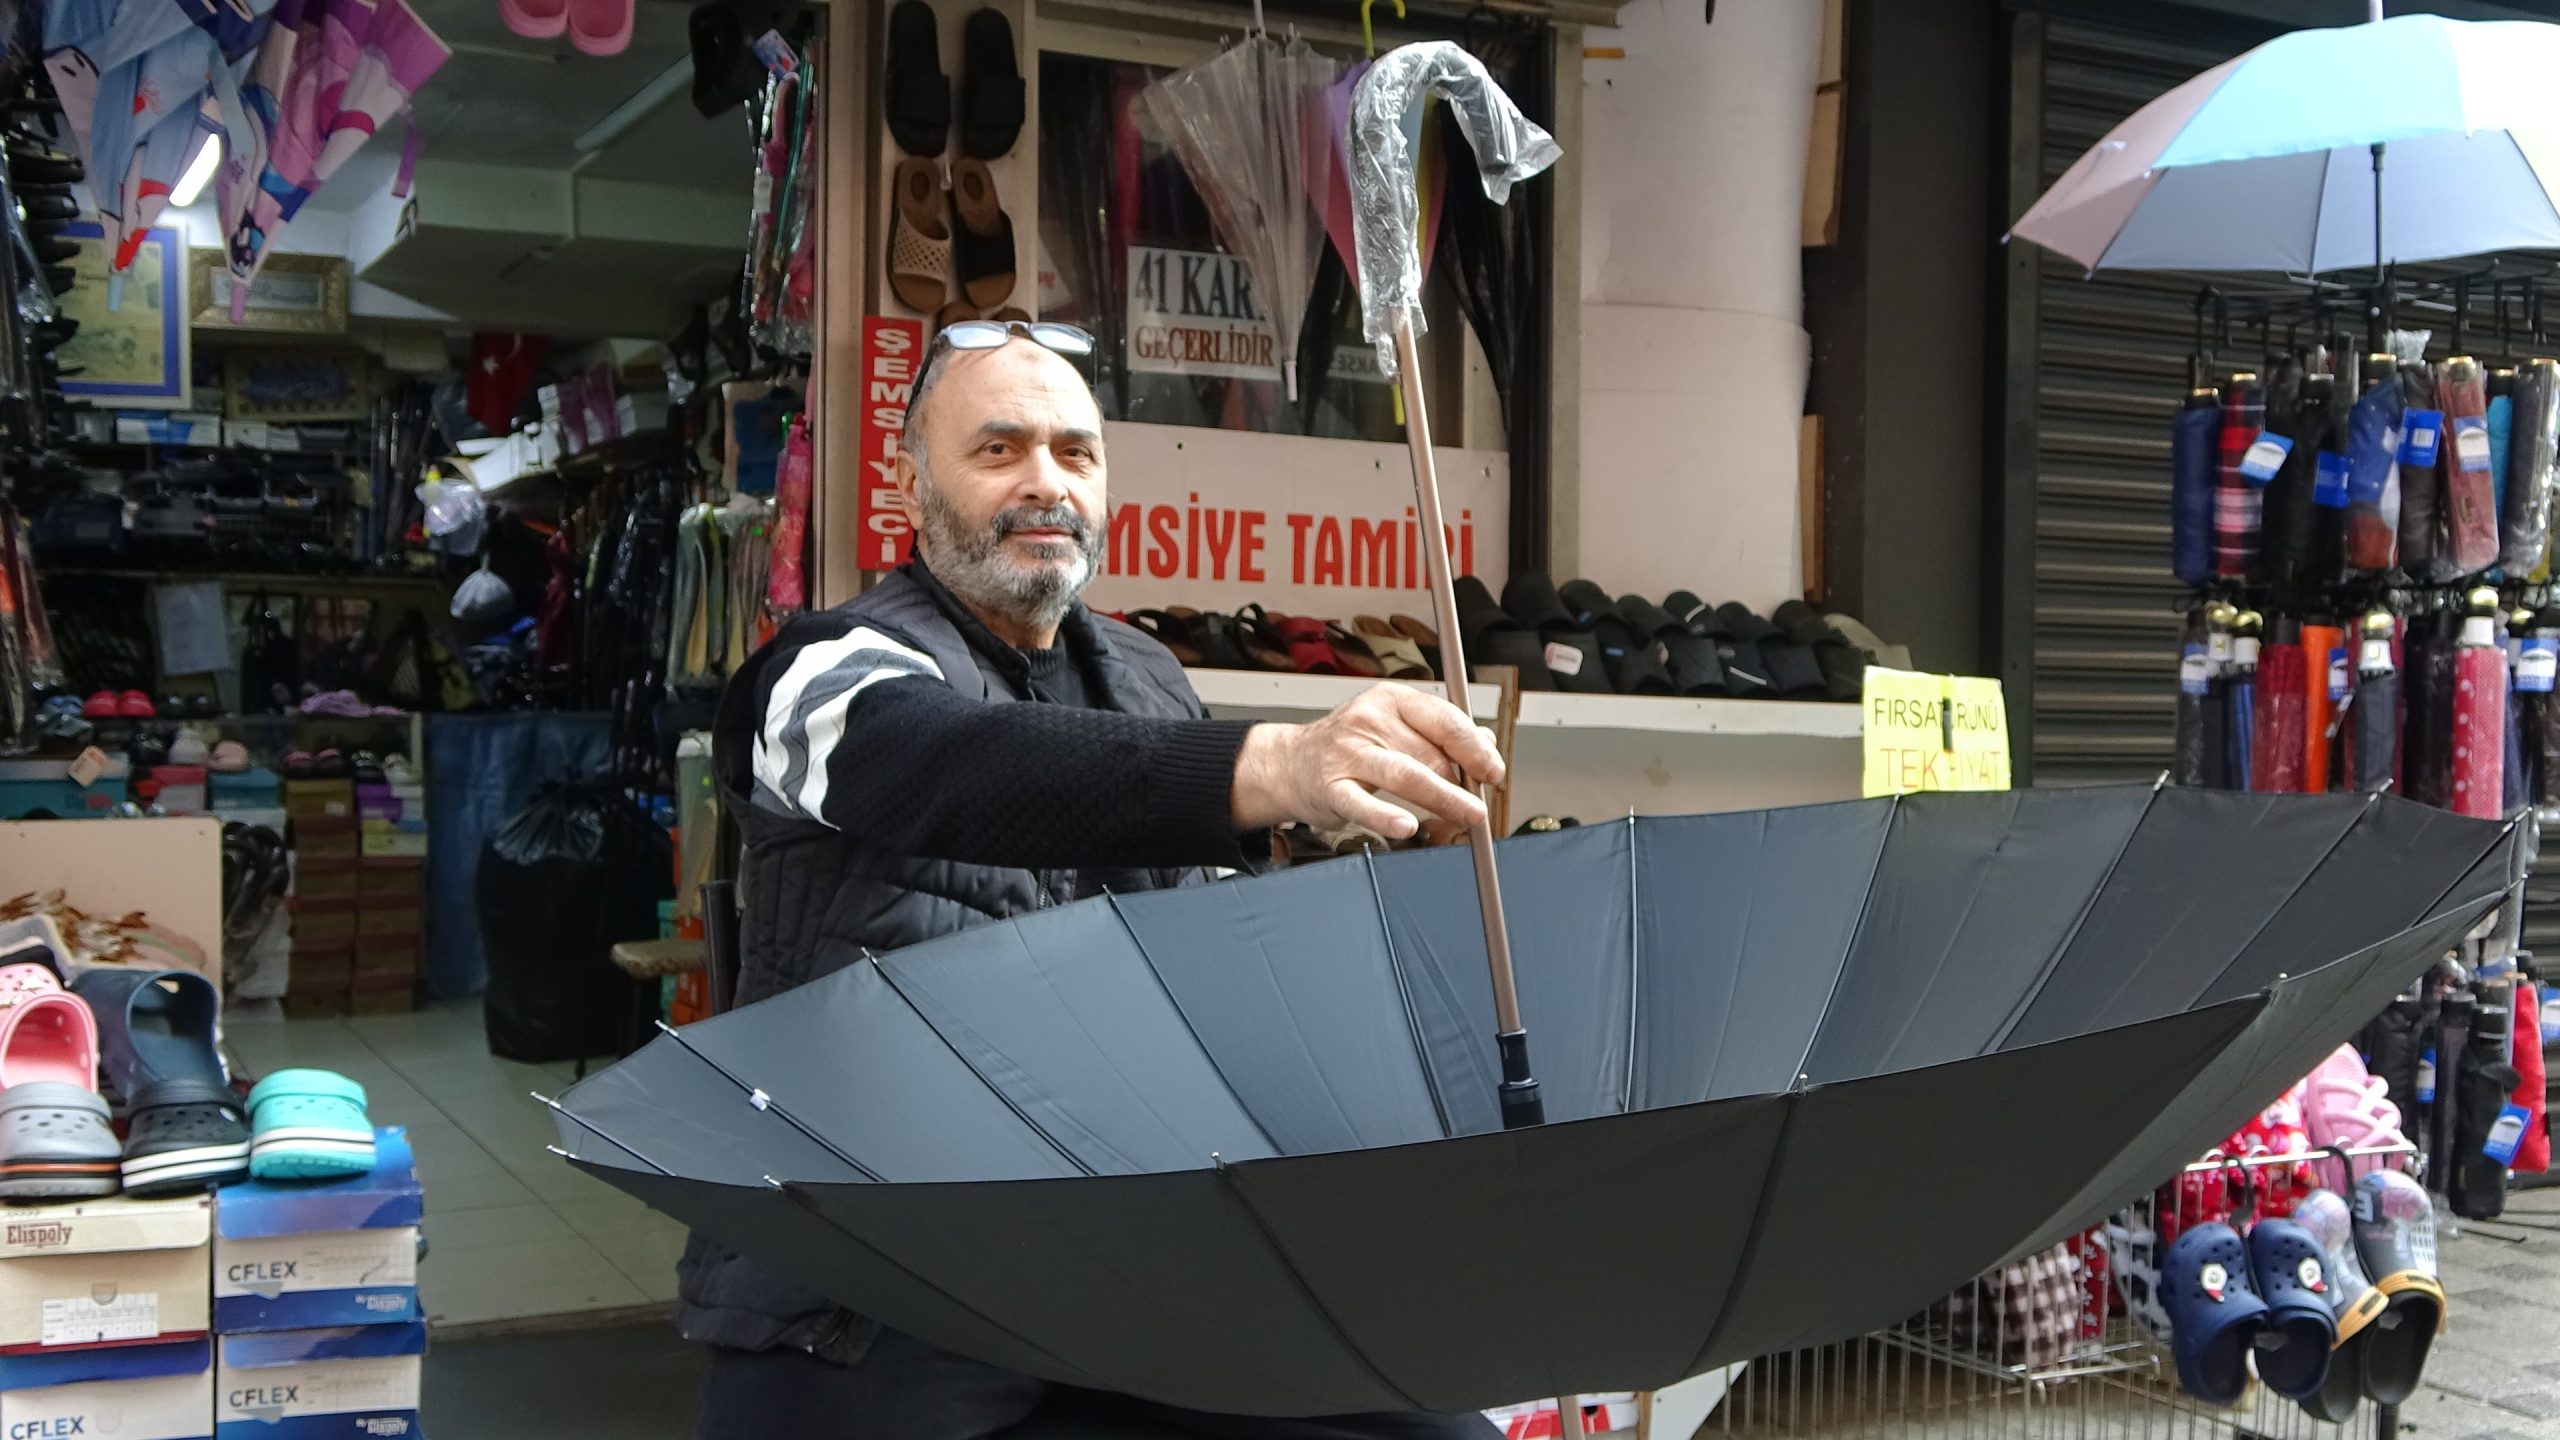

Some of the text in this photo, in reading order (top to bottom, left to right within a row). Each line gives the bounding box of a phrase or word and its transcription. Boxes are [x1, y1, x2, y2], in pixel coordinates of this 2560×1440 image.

[1179, 255, 1266, 321] KAR
[1135, 323, 1275, 368] GEÇERLİDİR
[868, 328, 912, 563] ŞEMSİYECİ
[1098, 491, 1265, 583] MSİYE
[1950, 698, 1999, 731] RÜNÜ
[1880, 748, 1939, 790] TEK
[6, 1221, 73, 1248] Elispoly
[228, 1260, 297, 1282] CFLEX
[229, 1386, 299, 1407] CFLEX
[10, 1415, 84, 1440] CFLEX
